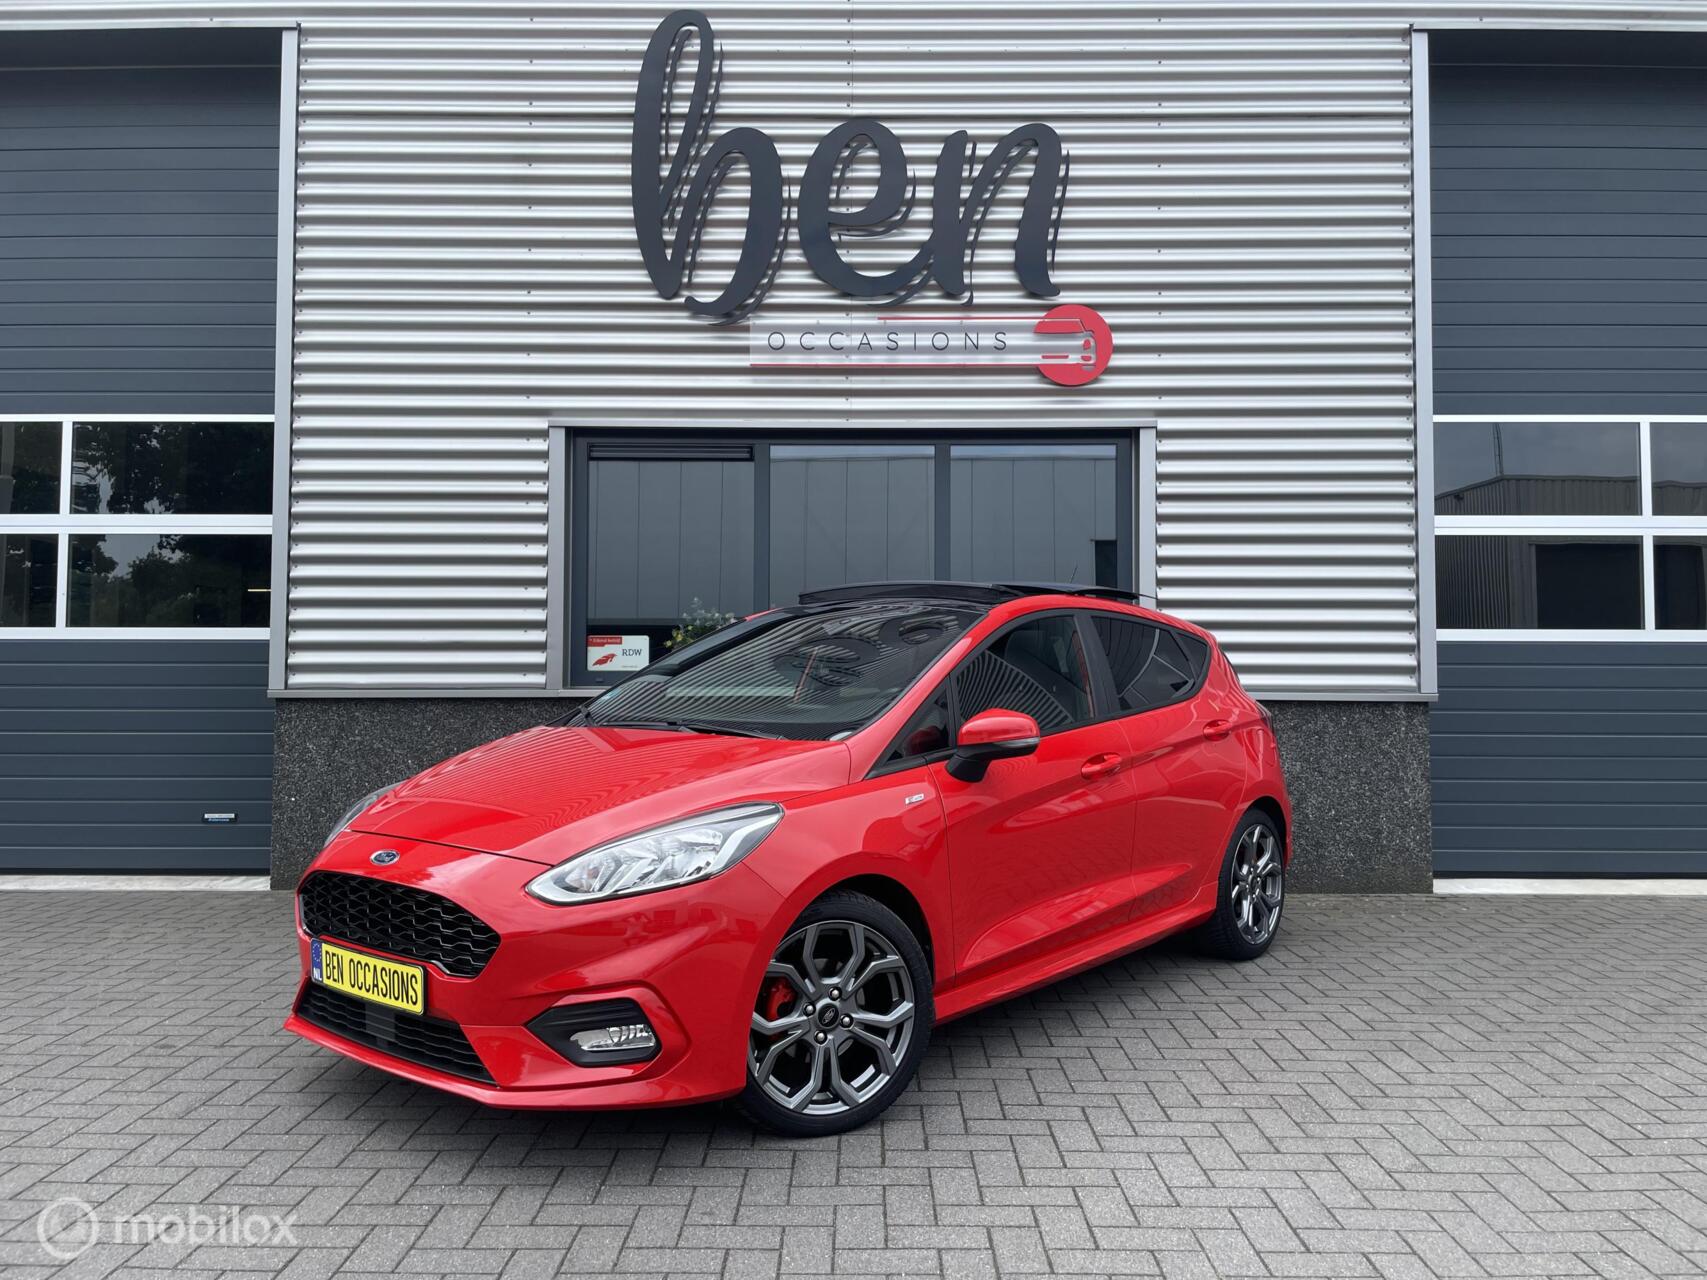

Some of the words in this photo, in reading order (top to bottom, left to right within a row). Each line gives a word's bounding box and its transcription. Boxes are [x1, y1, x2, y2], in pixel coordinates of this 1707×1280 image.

[632, 9, 1064, 320] ben
[768, 331, 1008, 351] OCCASIONS
[325, 950, 344, 985] BEN
[349, 958, 418, 1006] OCCASIONS
